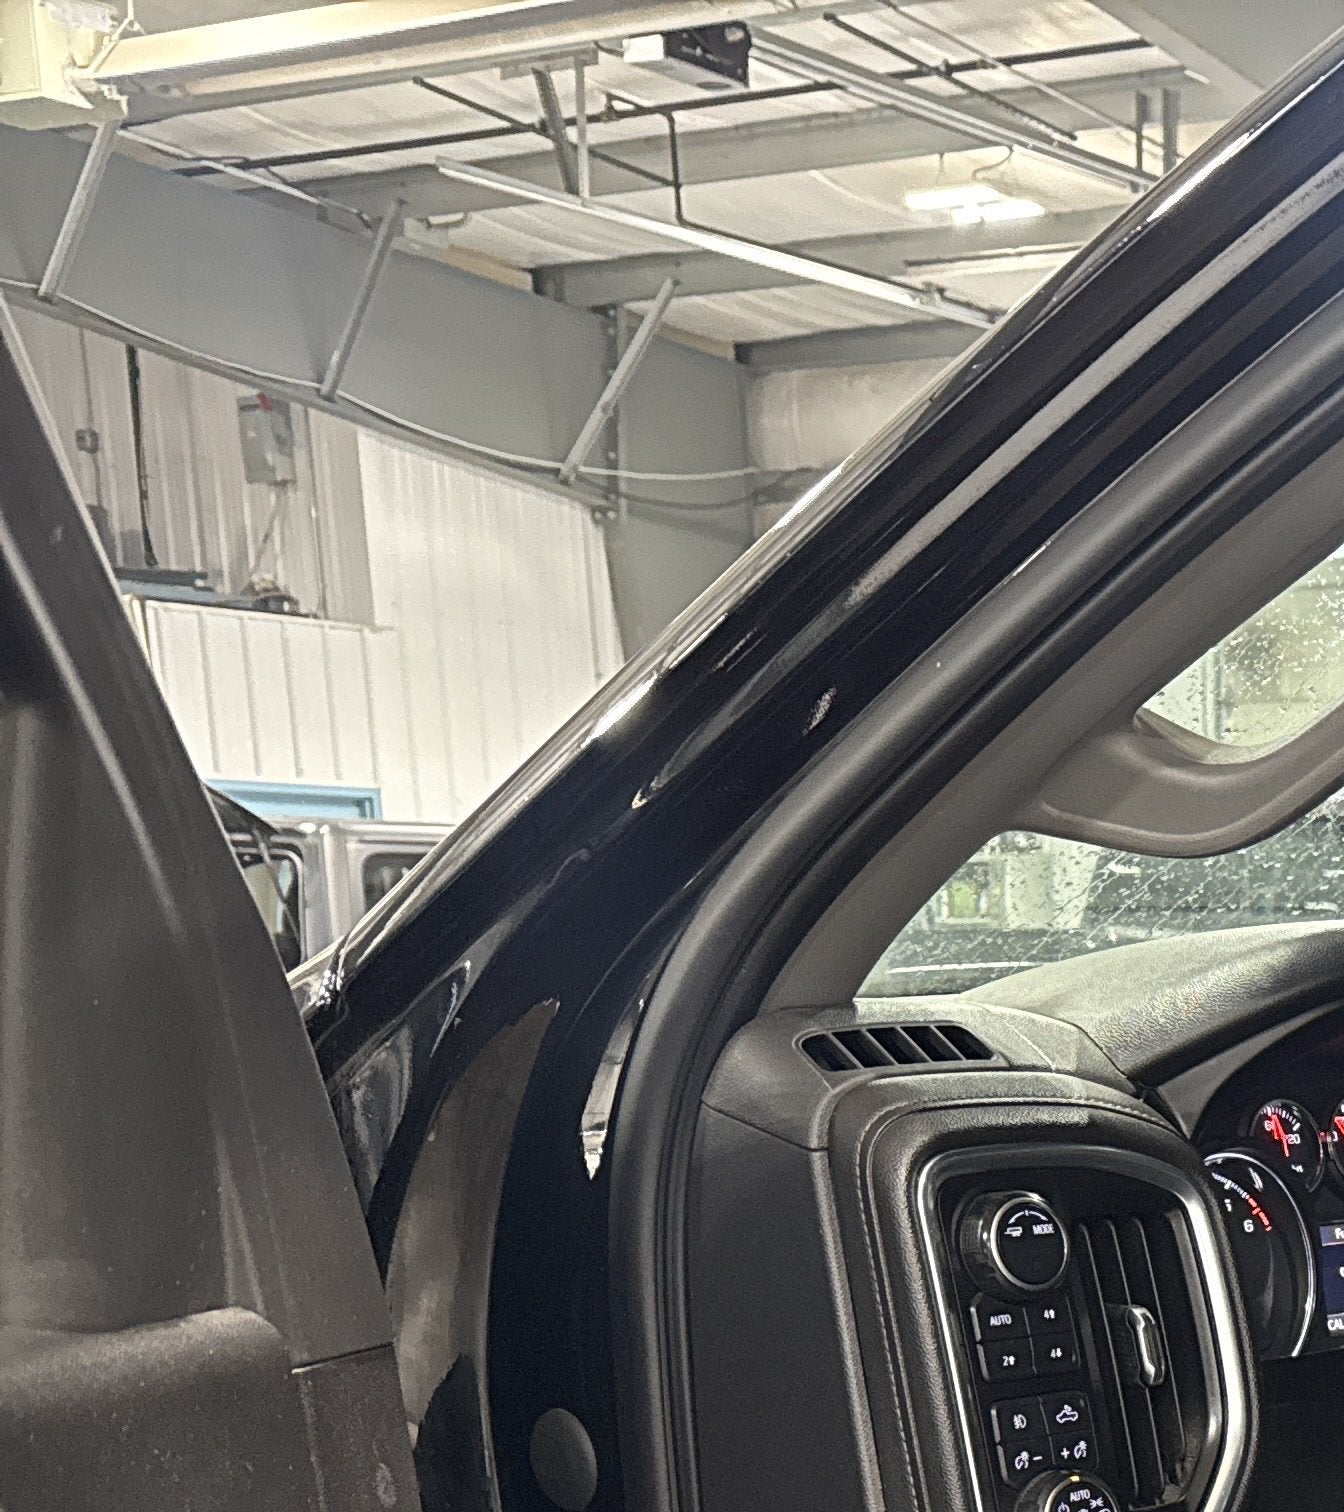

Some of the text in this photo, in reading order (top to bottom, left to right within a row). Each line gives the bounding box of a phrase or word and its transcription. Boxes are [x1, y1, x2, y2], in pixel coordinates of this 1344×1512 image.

[1032, 1223, 1055, 1235] MODE
[1243, 1219, 1254, 1233] 6
[990, 1314, 1012, 1326] AUTO
[1070, 1488, 1091, 1503] AUTO
